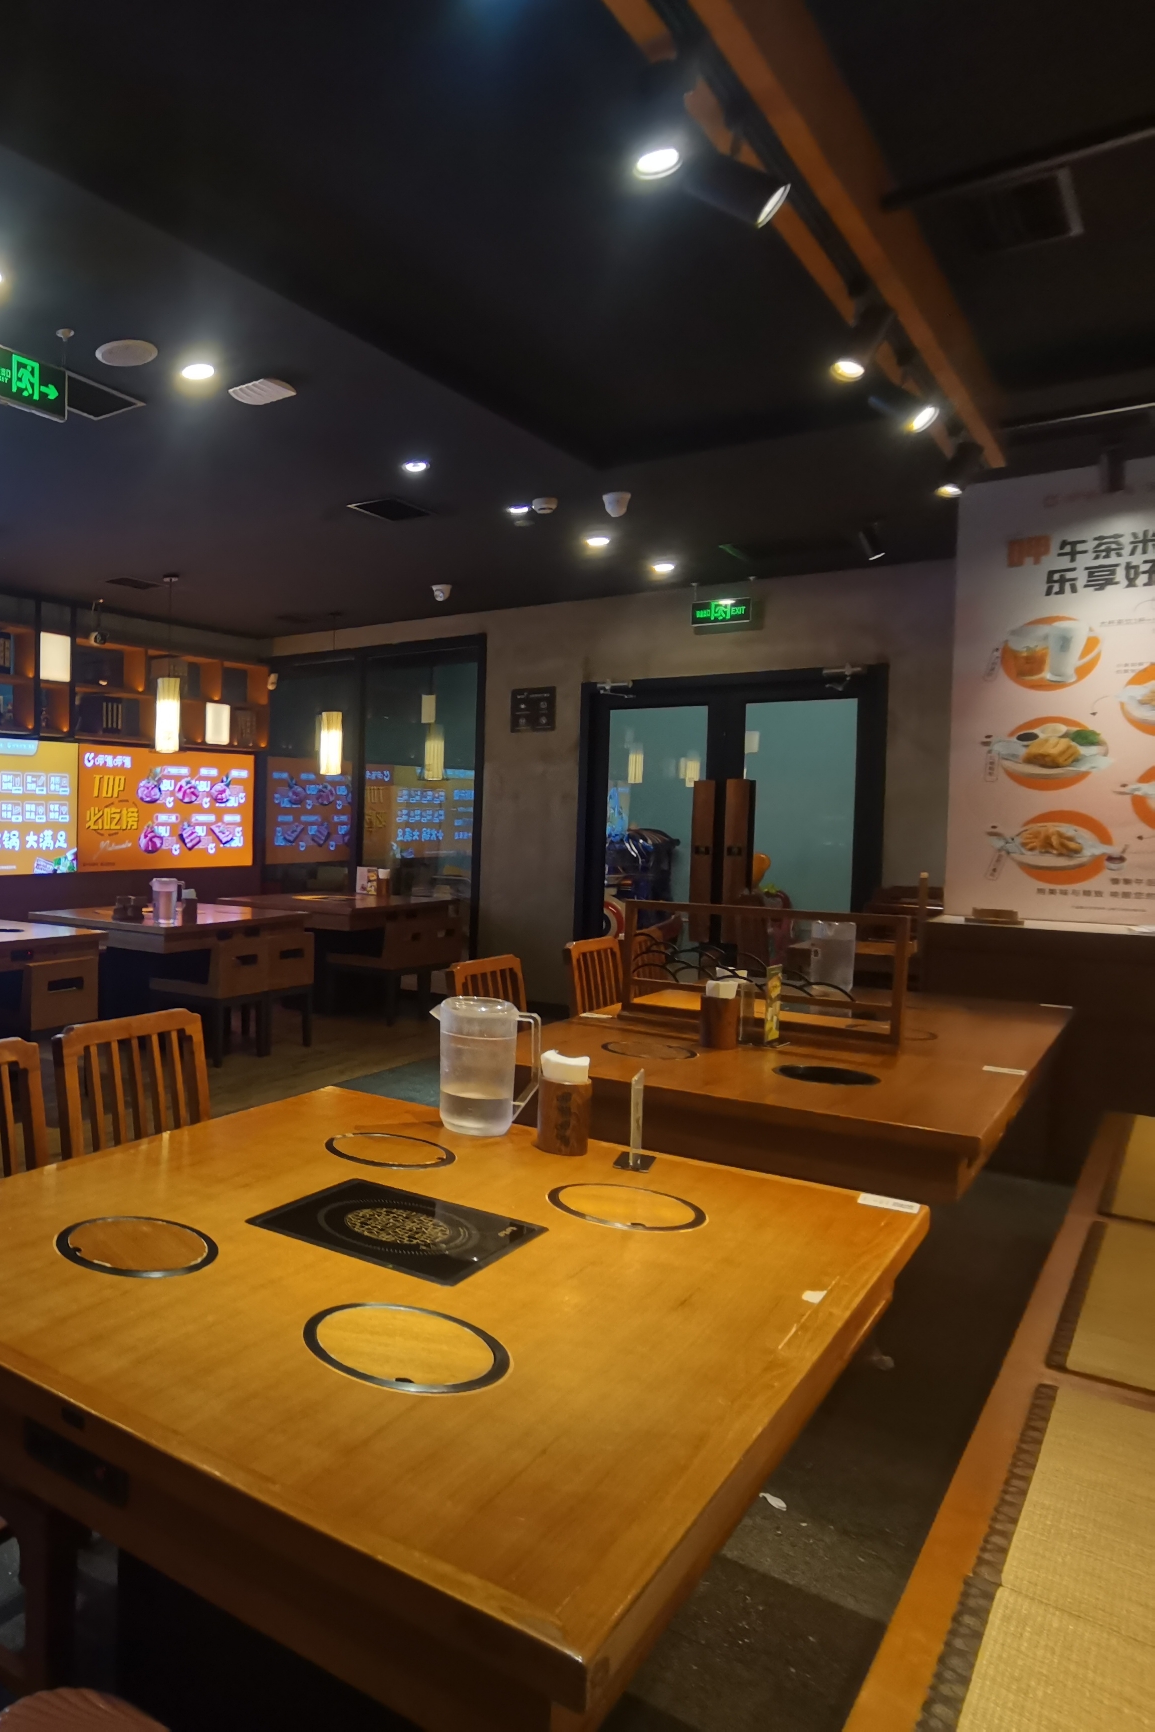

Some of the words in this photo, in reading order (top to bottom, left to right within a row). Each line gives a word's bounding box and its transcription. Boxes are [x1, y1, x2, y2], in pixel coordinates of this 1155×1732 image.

[731, 606, 746, 615] EXIT
[92, 774, 127, 798] TOP
[85, 807, 140, 831] 必吃榜
[25, 829, 68, 850] 大满足
